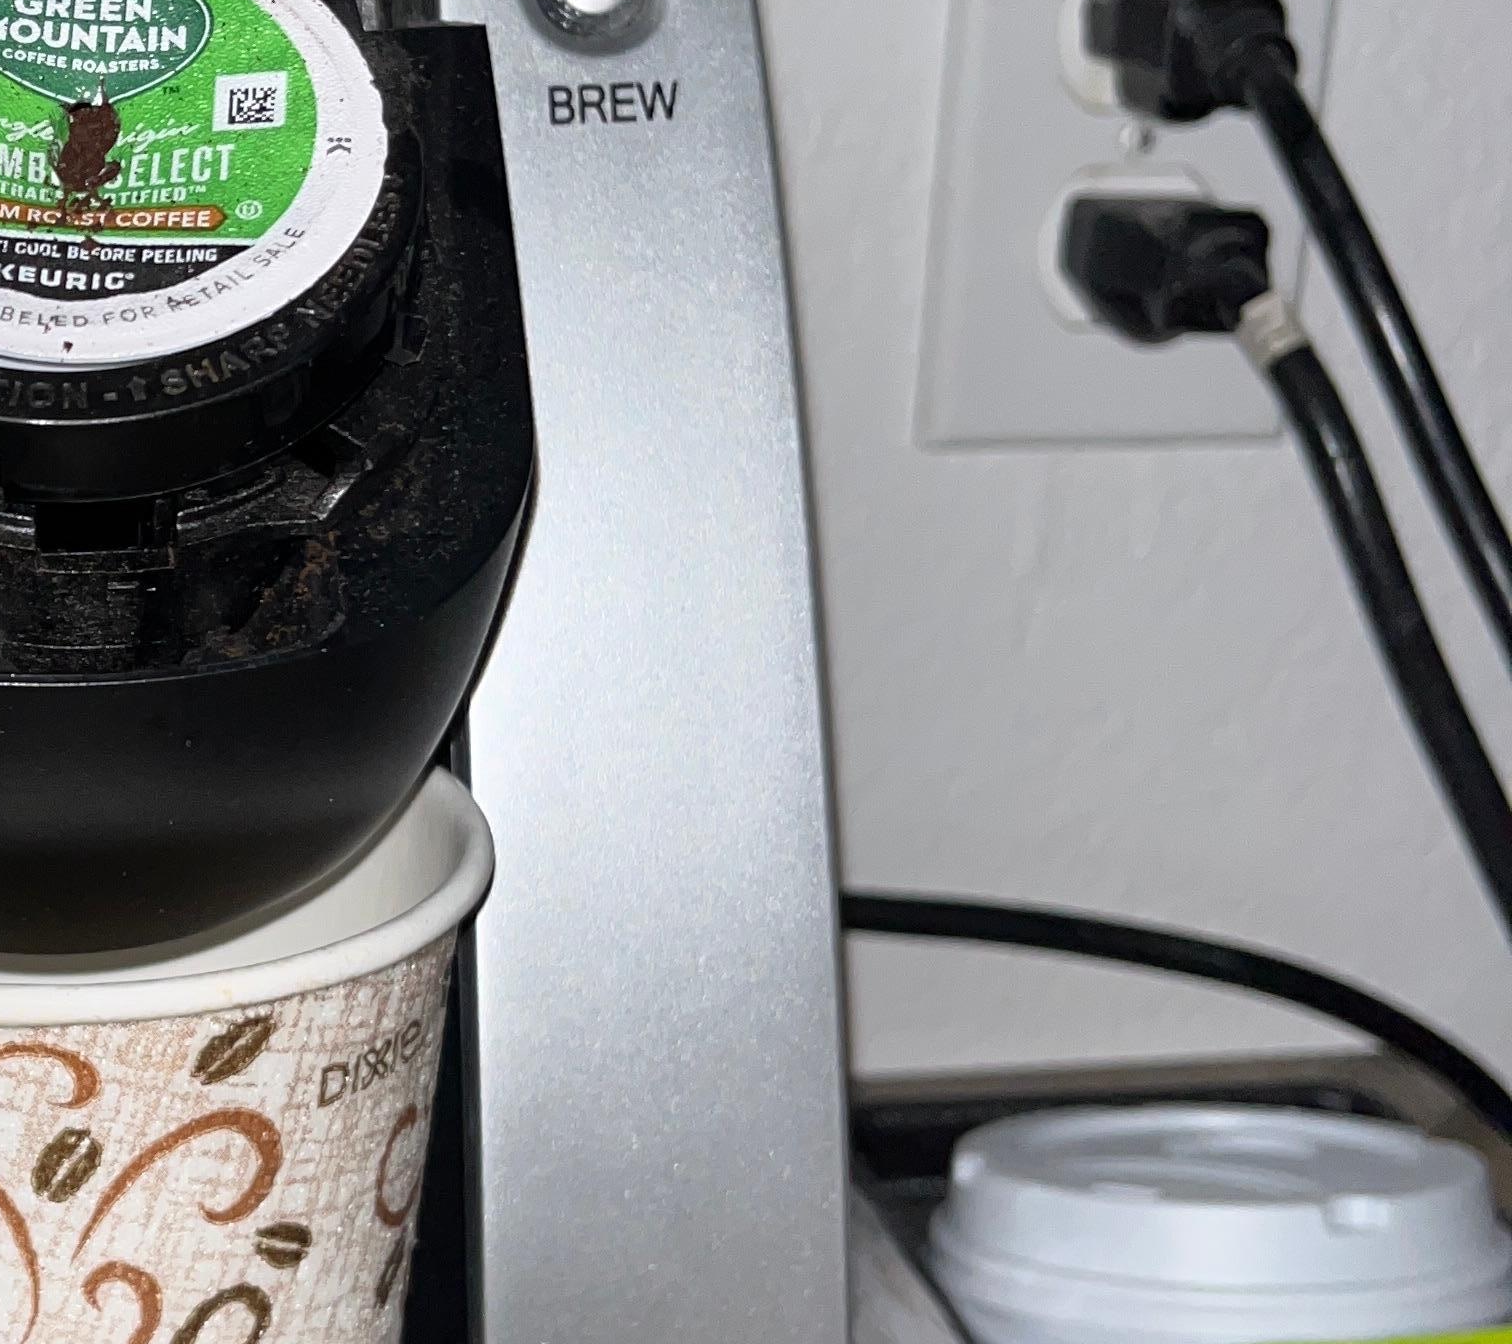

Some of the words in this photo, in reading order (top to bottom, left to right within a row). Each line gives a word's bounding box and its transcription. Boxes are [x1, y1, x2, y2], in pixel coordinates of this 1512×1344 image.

[1, 47, 68, 69] COFFEE
[547, 80, 679, 126] BREW
[115, 117, 203, 153] rigin
[26, 207, 107, 227] ROST
[115, 208, 211, 228] COFFEE
[14, 240, 61, 259] COOL
[141, 248, 218, 264] PEELING
[102, 305, 157, 326] FOR
[166, 271, 255, 312] RETAIL
[252, 226, 306, 268] SALE
[159, 322, 290, 397] SHARP
